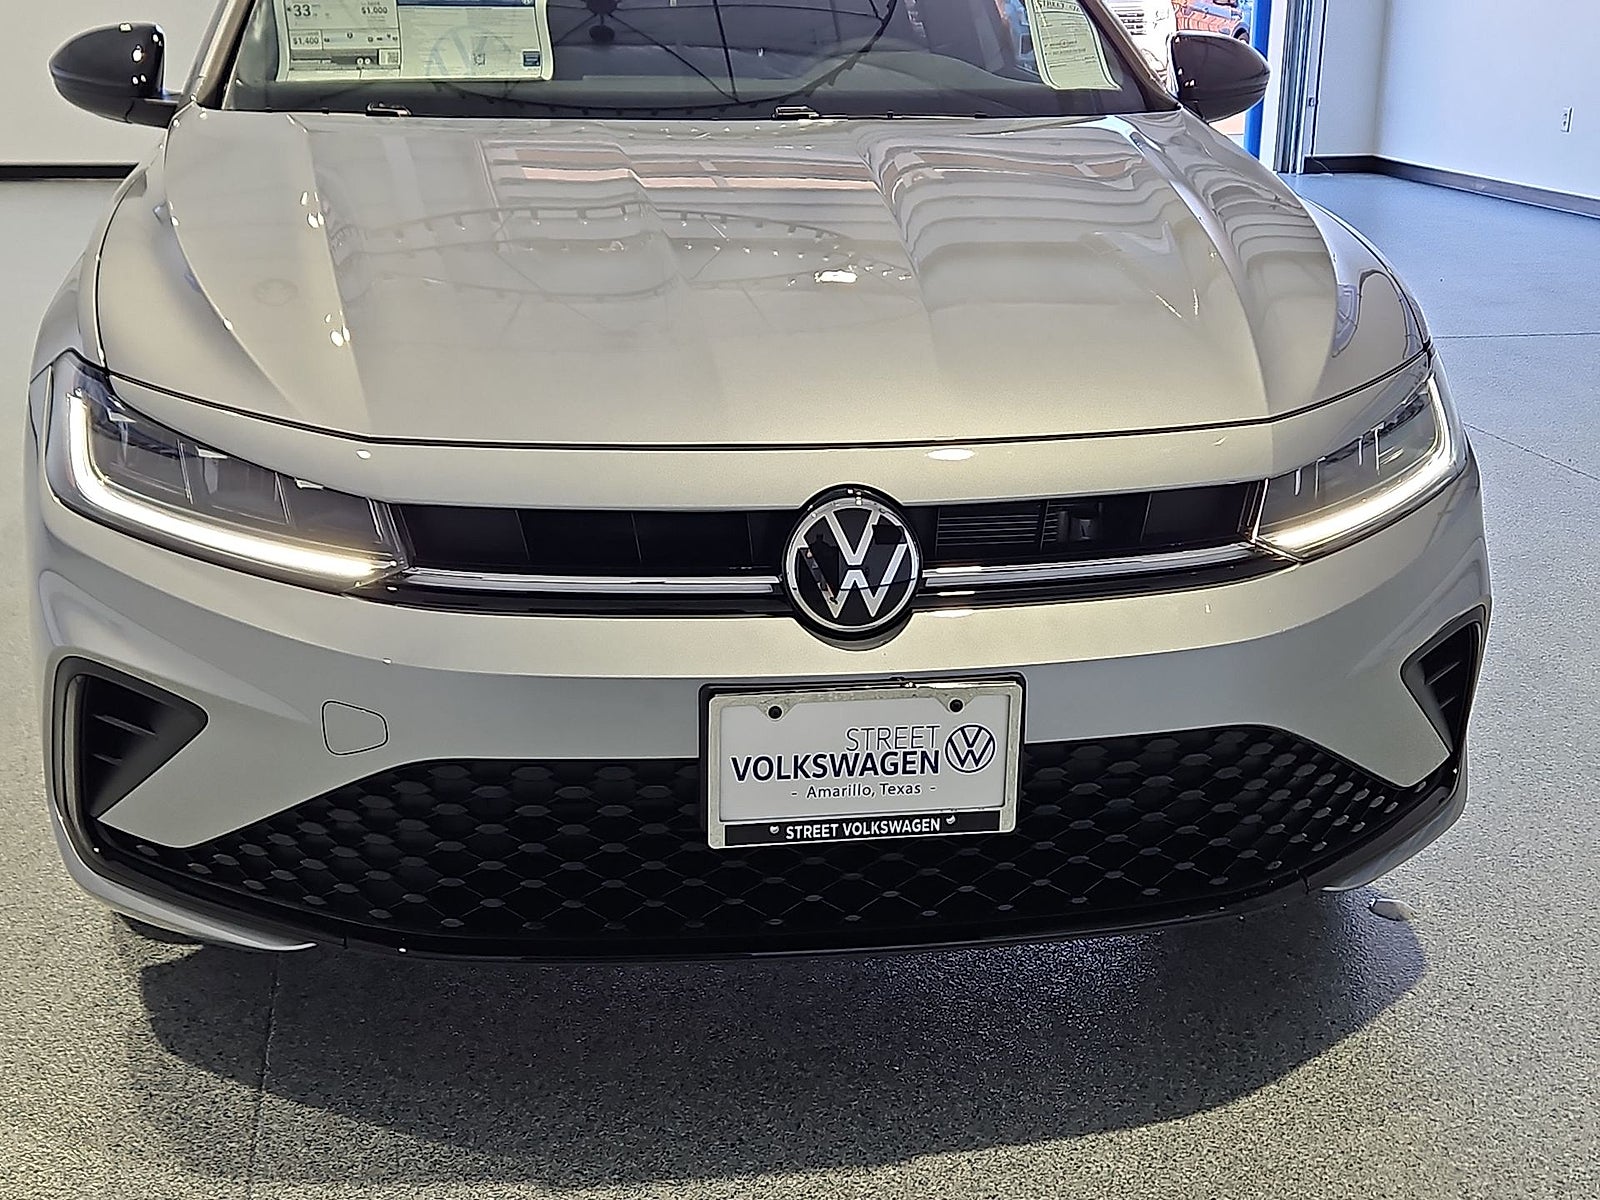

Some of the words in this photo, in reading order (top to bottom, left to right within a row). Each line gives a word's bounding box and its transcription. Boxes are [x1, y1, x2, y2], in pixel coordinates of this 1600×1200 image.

[293, 4, 311, 17] 33
[361, 6, 388, 14] $1,000
[293, 37, 319, 45] $1,400
[845, 725, 940, 751] STREET
[731, 750, 940, 782] VOLKSWAGEN
[807, 783, 876, 799] Amarillo,
[880, 782, 922, 796] Texas
[786, 821, 838, 839] STREET
[842, 817, 940, 837] VOLKSWAGEN
